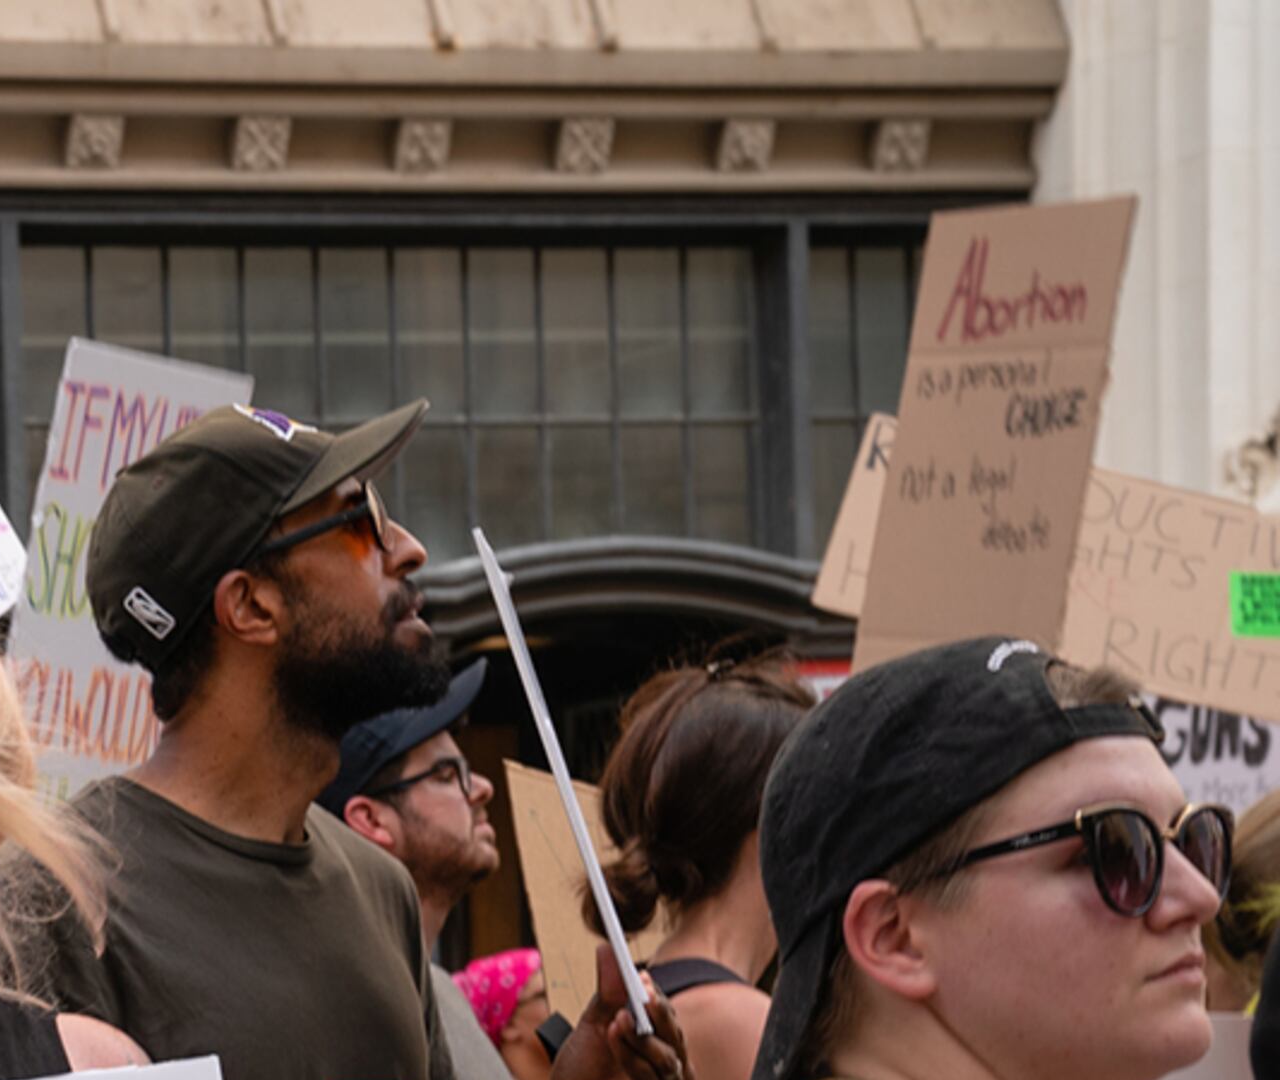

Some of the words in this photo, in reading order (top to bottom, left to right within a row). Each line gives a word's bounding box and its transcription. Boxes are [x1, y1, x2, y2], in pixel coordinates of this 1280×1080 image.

[936, 235, 1088, 344] Abortion
[954, 350, 1053, 408] personal
[1003, 385, 1088, 440] CHOICE
[899, 452, 937, 506] not
[941, 469, 957, 500] a
[968, 451, 1018, 523] legal
